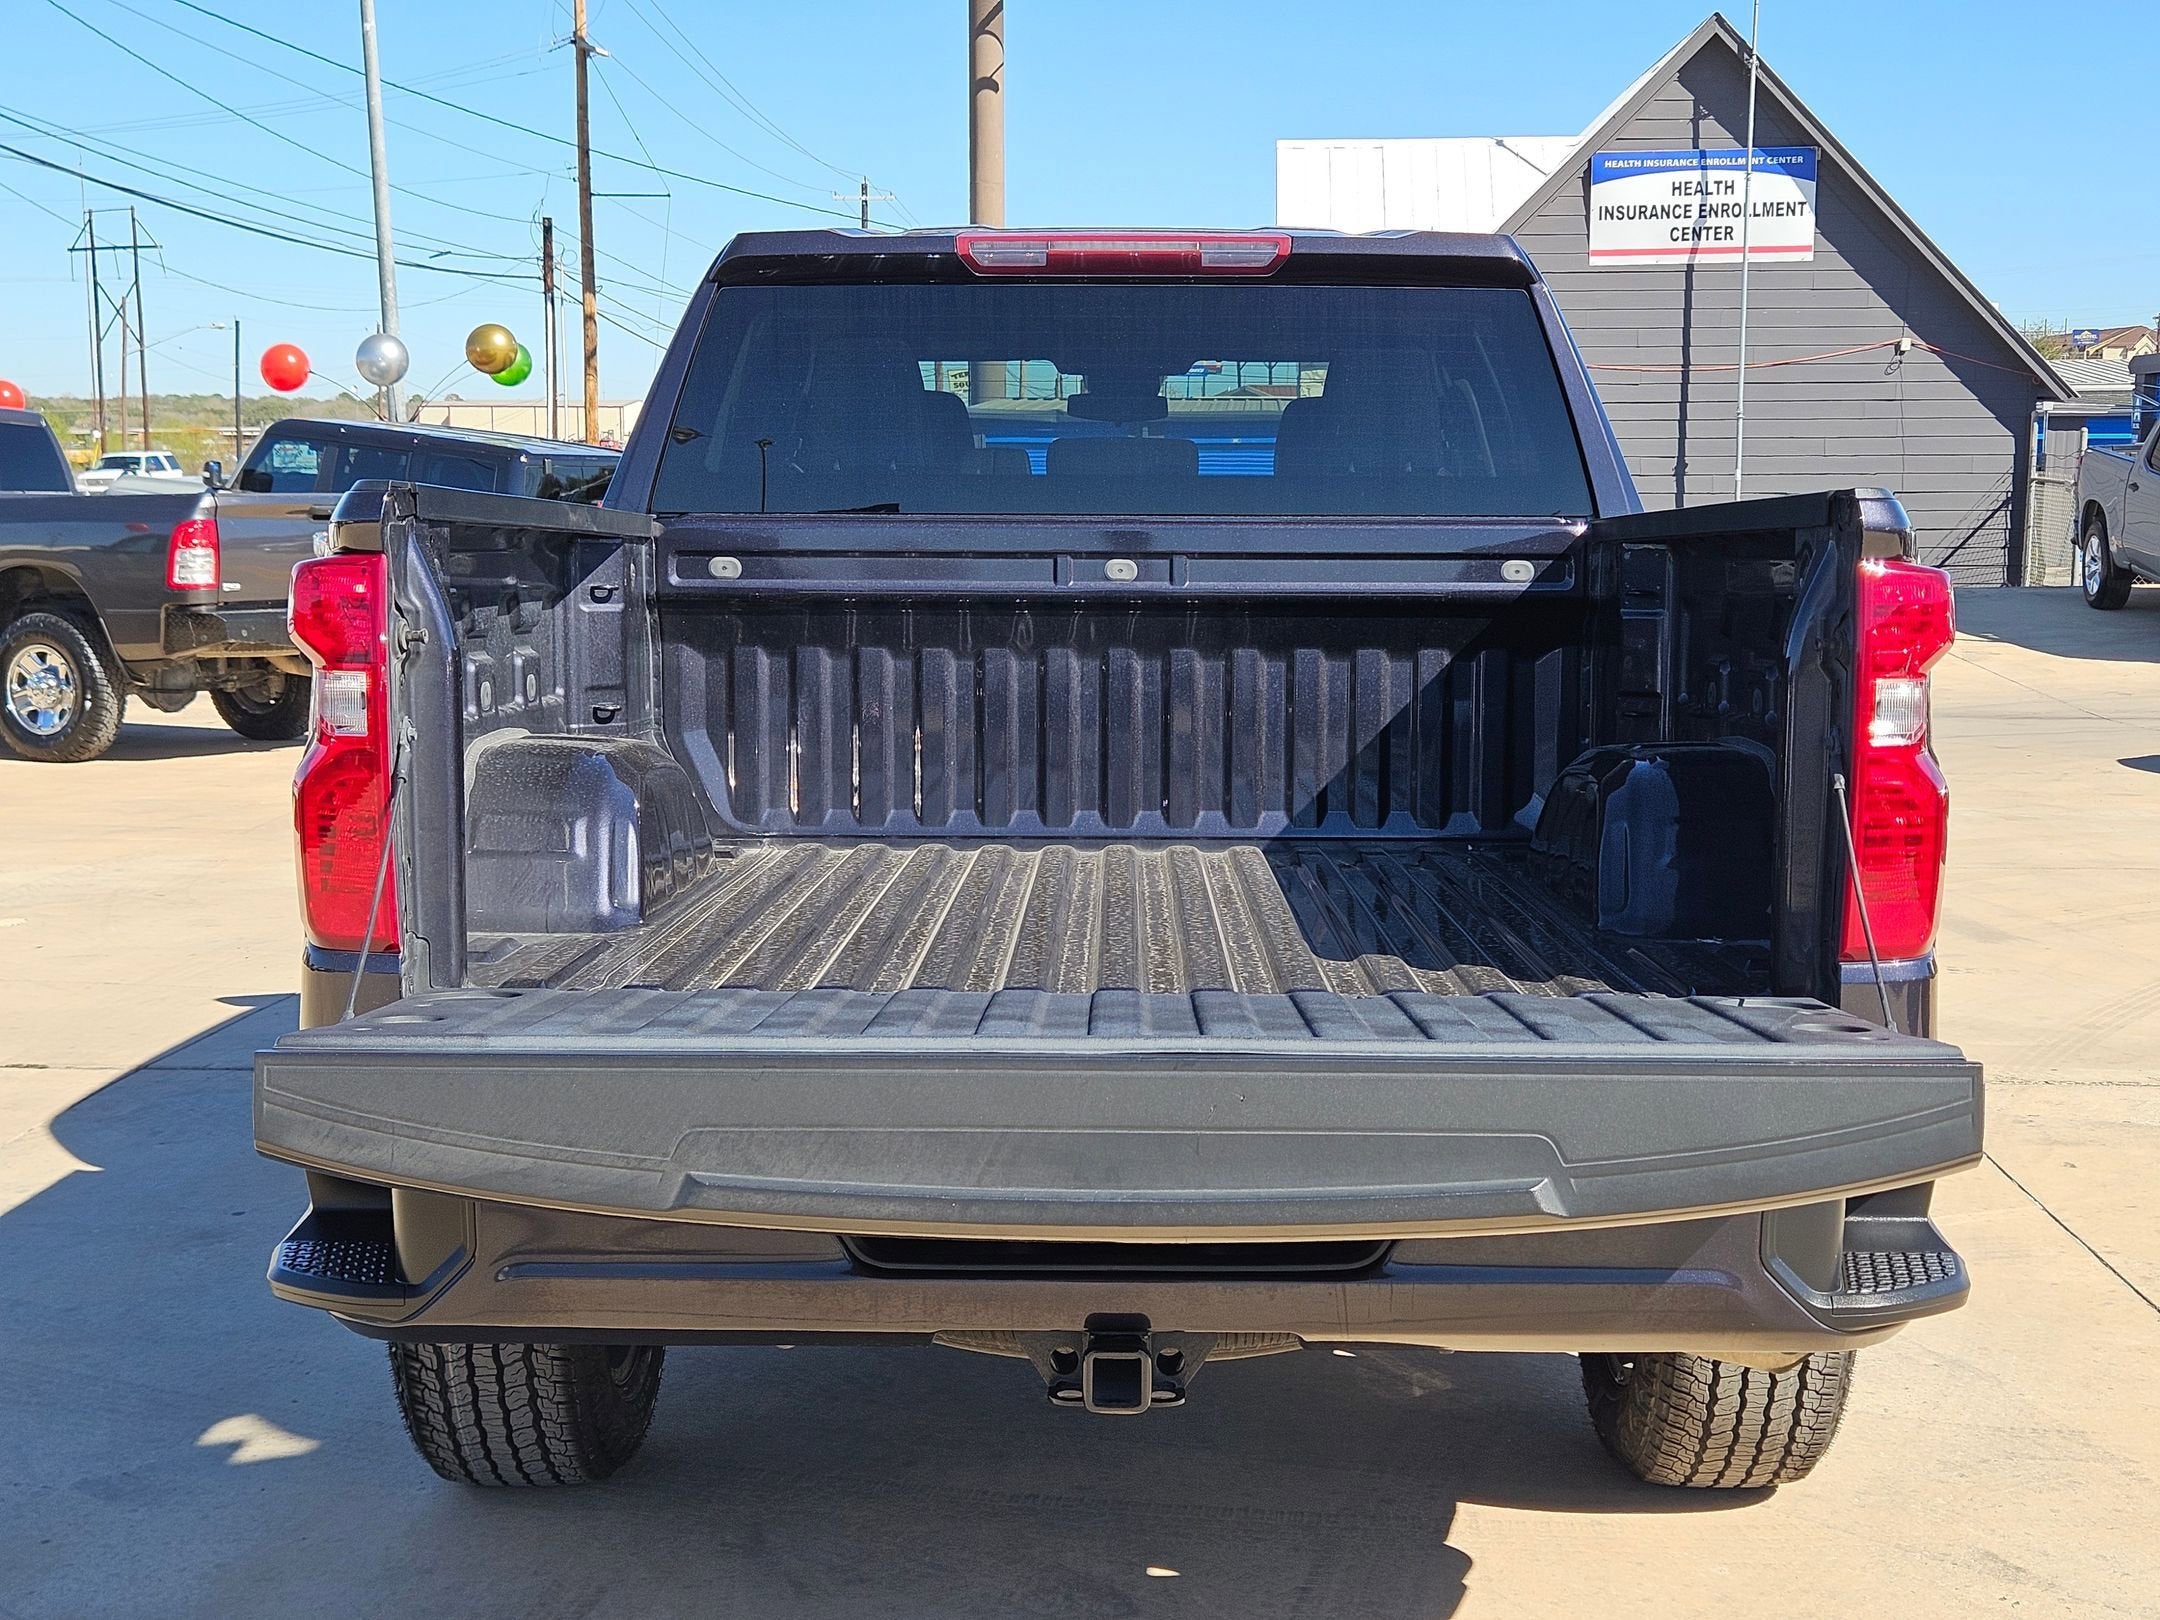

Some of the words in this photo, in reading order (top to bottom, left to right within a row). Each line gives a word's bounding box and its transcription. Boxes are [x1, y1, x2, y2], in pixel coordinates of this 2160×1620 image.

[1604, 158, 1642, 168] HEALTH
[1643, 157, 1699, 168] INSURANCE
[1700, 156, 1765, 167] ENROLLMNT
[1765, 155, 1804, 165] CENTER
[1671, 179, 1735, 197] HEALTH
[1598, 203, 1693, 221] INSURANCE
[1669, 225, 1734, 242] CENTER
